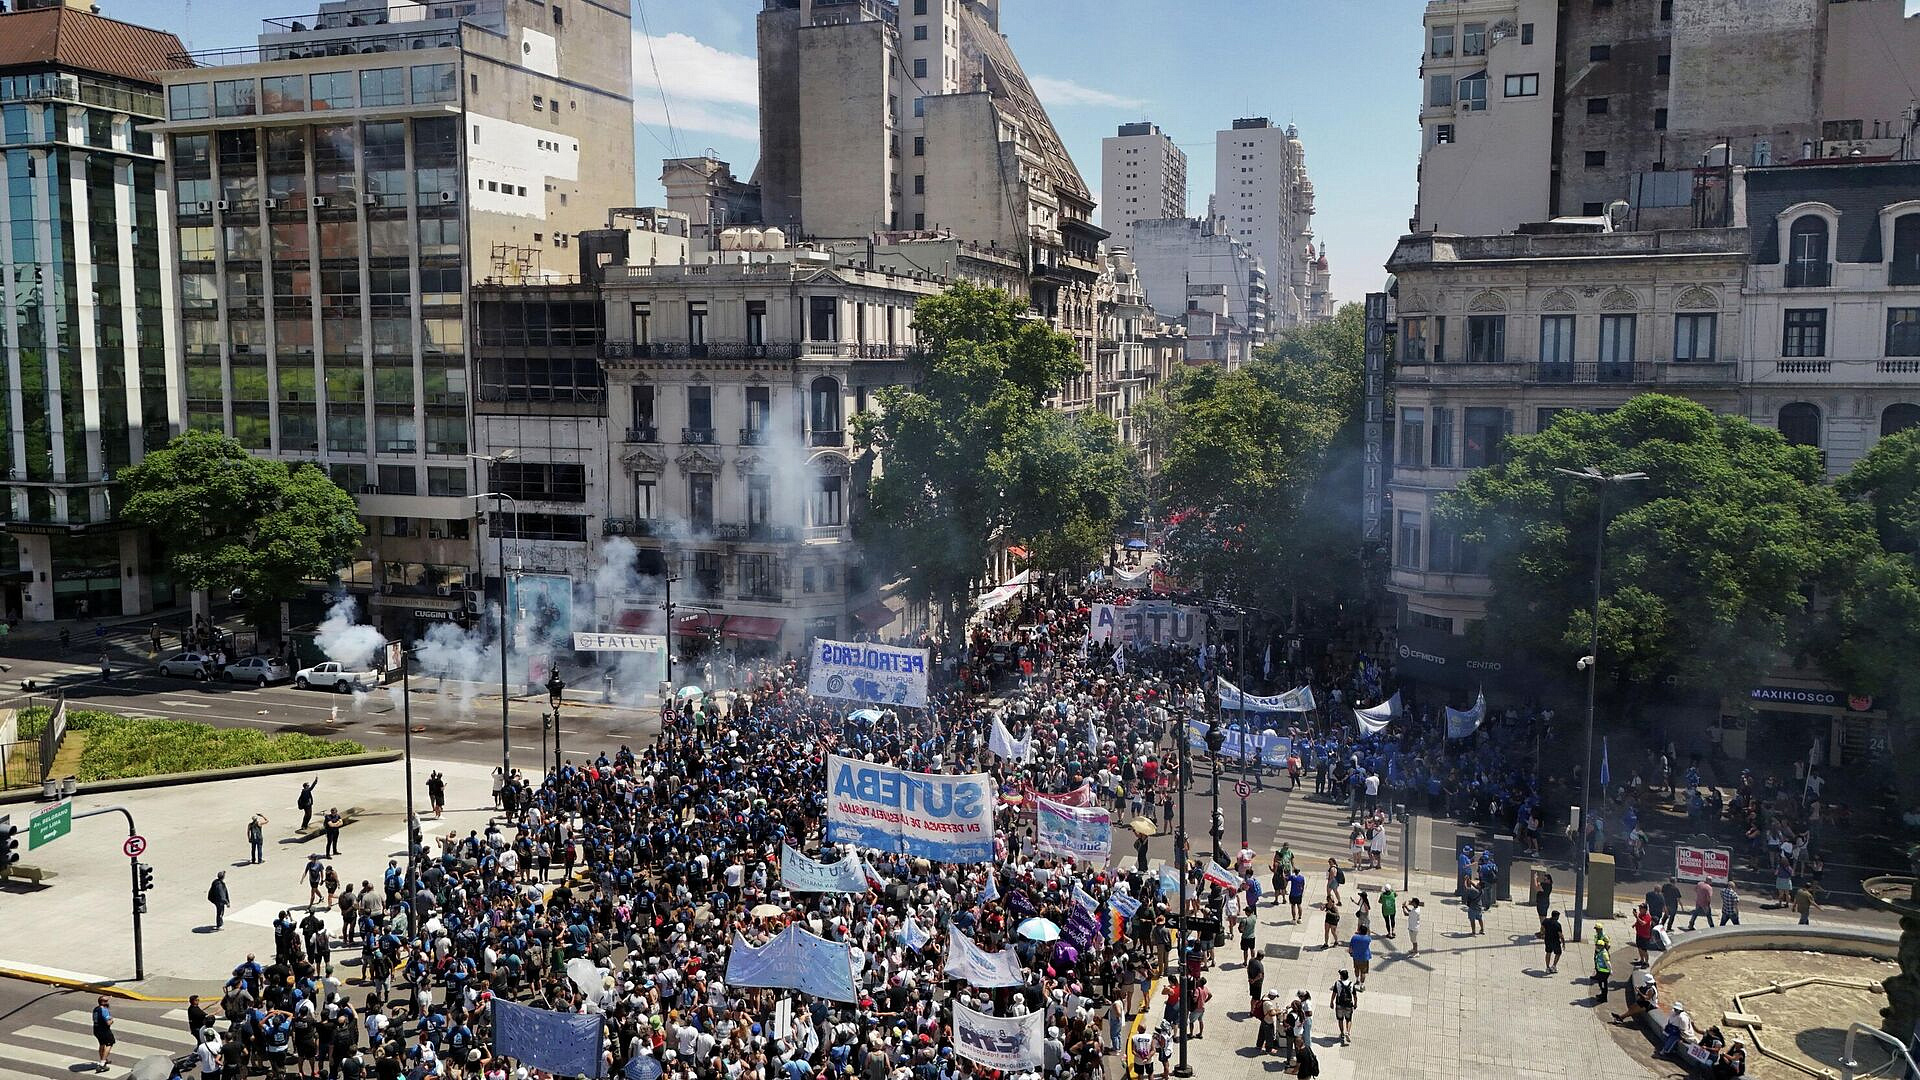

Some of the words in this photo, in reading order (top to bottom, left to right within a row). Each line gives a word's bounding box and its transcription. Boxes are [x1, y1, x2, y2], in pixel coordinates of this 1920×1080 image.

[1366, 442, 1381, 539] RITZ
[1466, 660, 1501, 670] CENTRO
[1751, 689, 1835, 703] MAXIKIOSCO
[1870, 738, 1885, 751] 24
[42, 808, 68, 824] BELGRANO
[49, 820, 61, 830] LIMA
[1680, 849, 1691, 858] NO
[1704, 852, 1716, 860] NO
